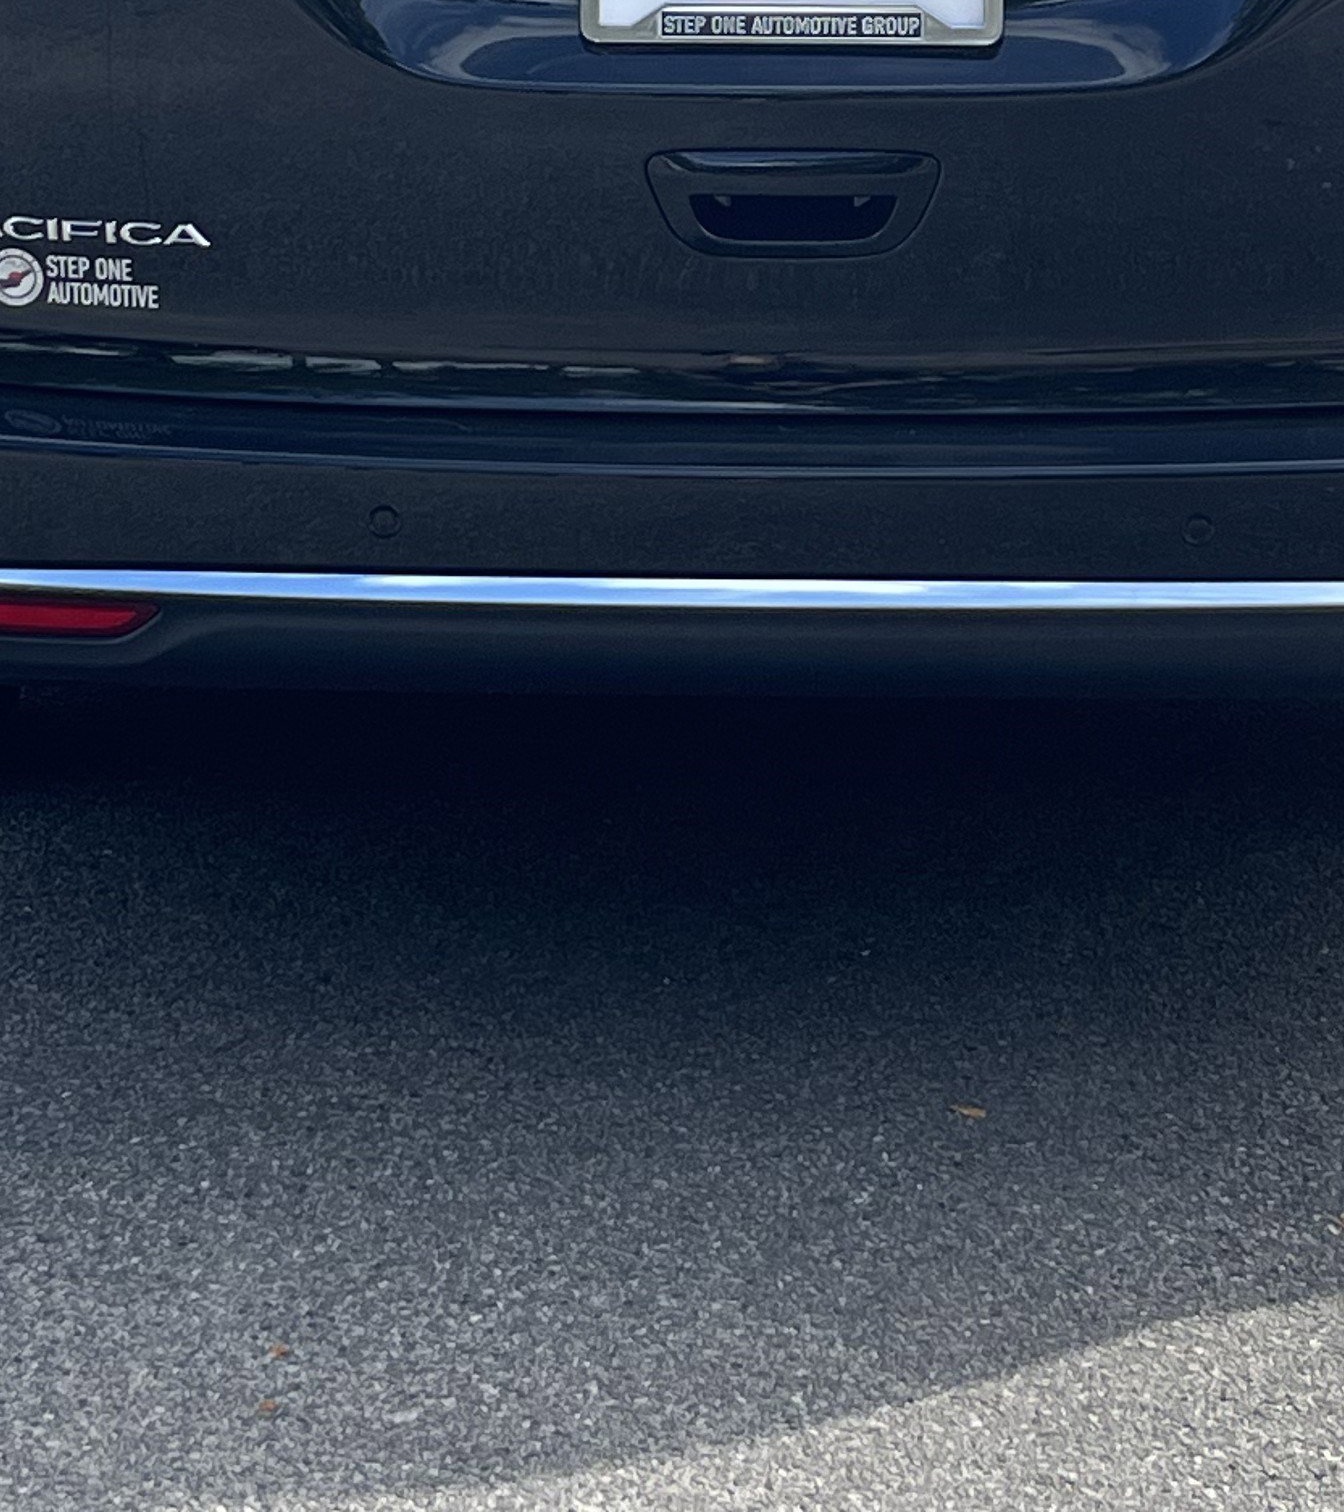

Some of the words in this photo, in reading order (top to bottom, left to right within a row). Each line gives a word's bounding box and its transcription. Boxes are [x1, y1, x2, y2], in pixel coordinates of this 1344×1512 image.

[663, 15, 706, 34] STEP
[711, 15, 747, 35] ONE
[751, 15, 857, 36] AUTOMOTIVE
[861, 16, 921, 36] GROUP
[45, 254, 90, 279] STEP
[94, 257, 133, 281] ONE
[47, 281, 160, 309] AUTOMOTIVE
